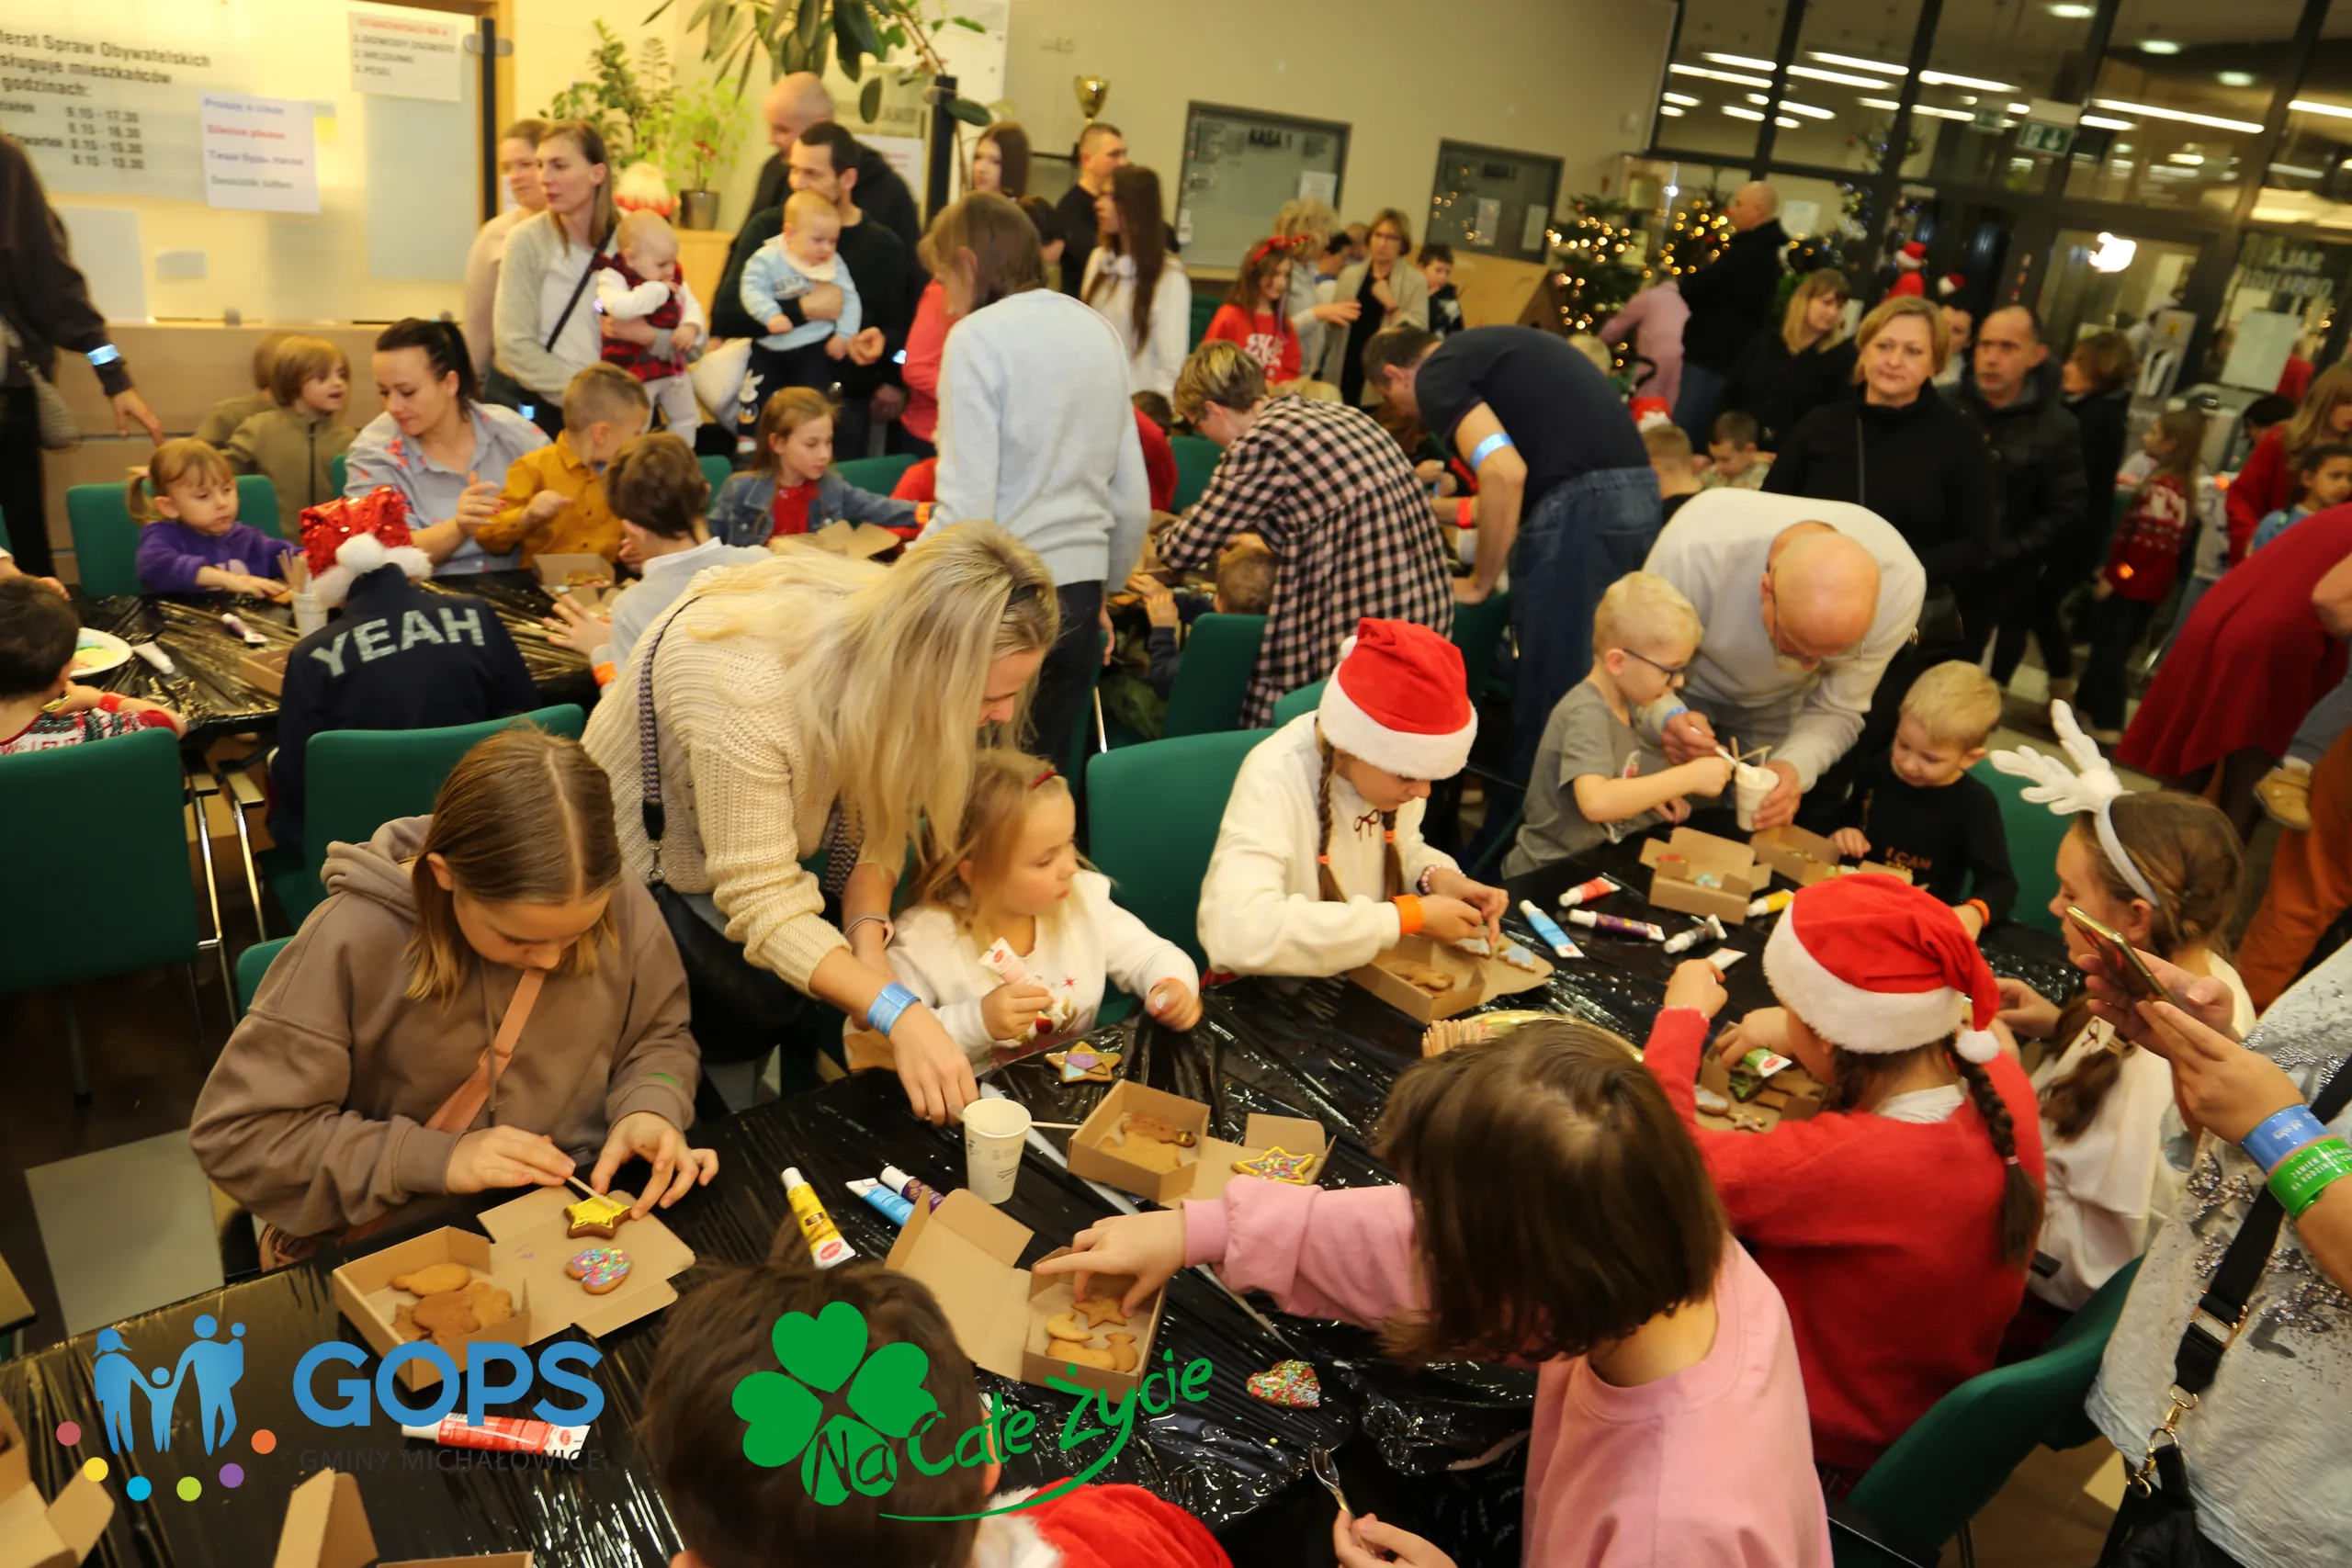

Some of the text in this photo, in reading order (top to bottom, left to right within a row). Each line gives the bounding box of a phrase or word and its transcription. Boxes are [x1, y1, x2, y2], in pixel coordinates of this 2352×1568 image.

[42, 33, 95, 55] Spraw
[100, 41, 211, 68] Obywatelskich
[1248, 127, 1283, 148] KASA
[310, 607, 486, 678] YEAH
